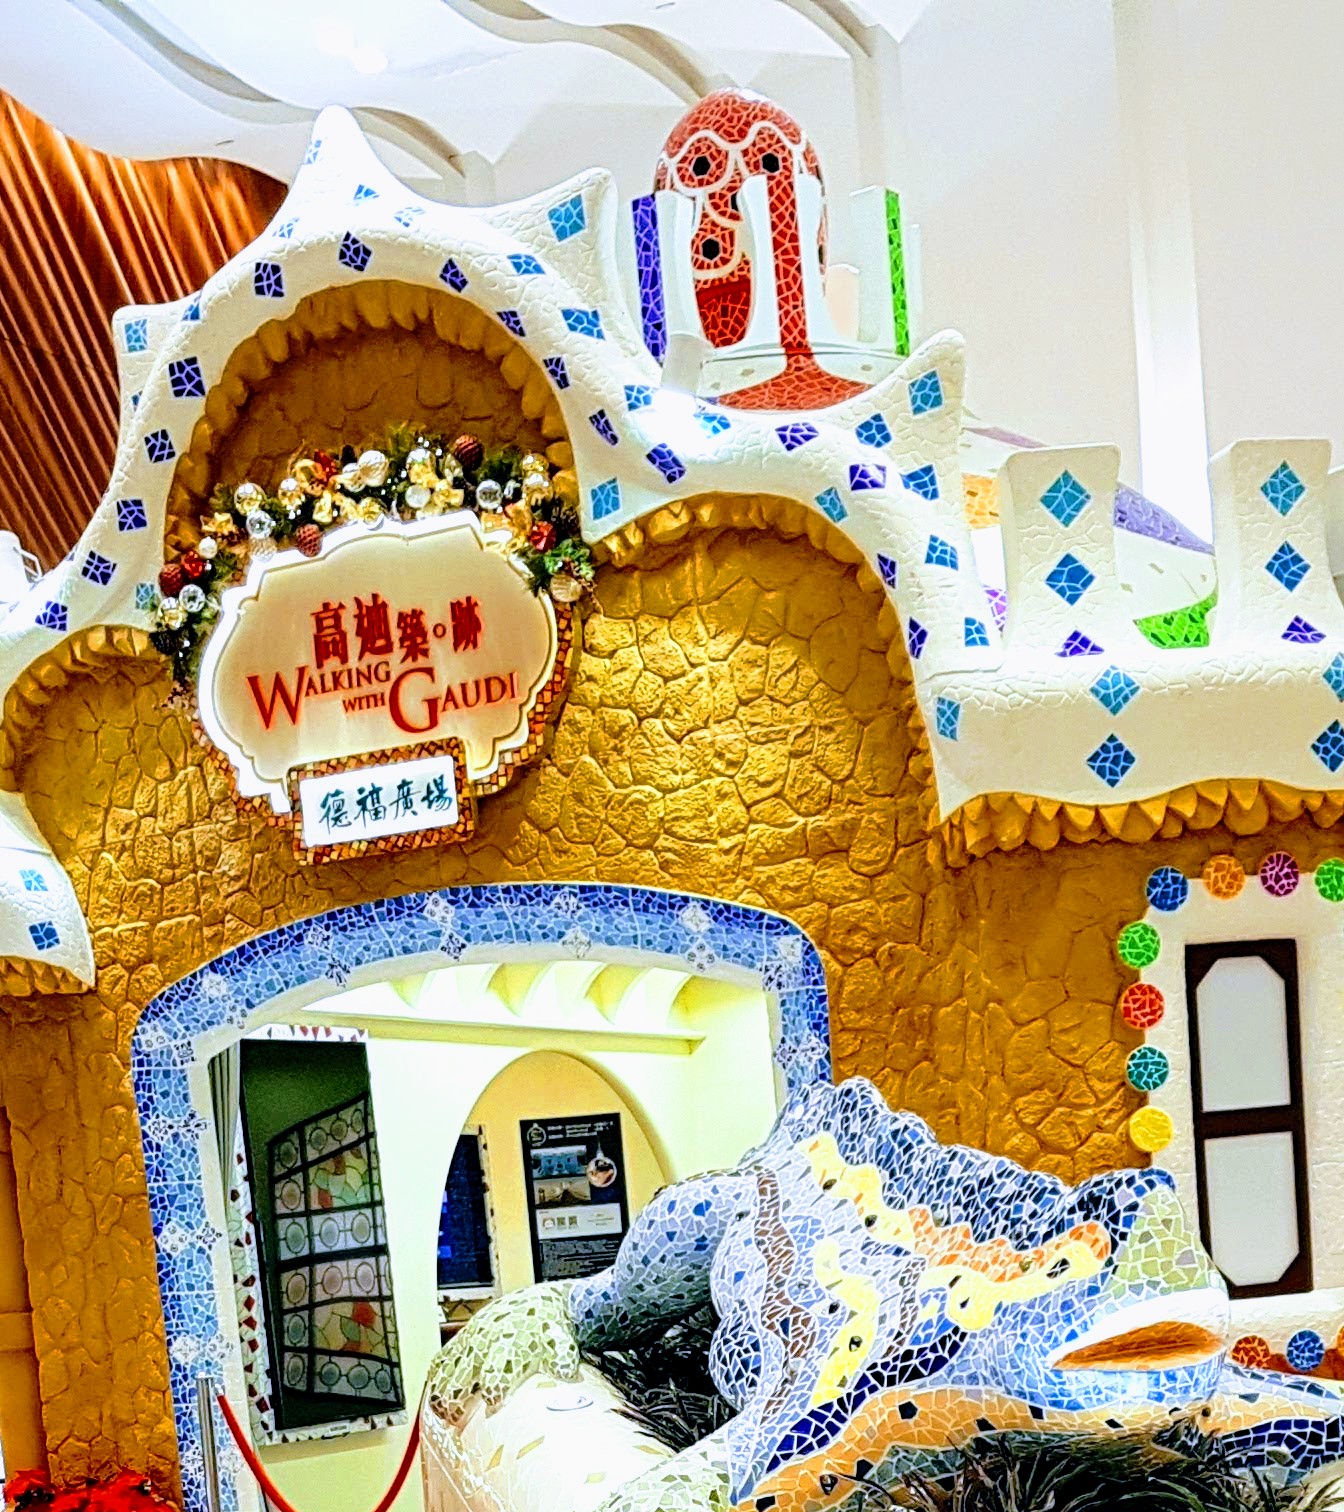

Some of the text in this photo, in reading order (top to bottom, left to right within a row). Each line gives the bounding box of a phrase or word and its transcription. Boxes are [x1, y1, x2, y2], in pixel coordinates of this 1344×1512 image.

[342, 692, 385, 712] WITH
[318, 774, 453, 833] 德福廣場
